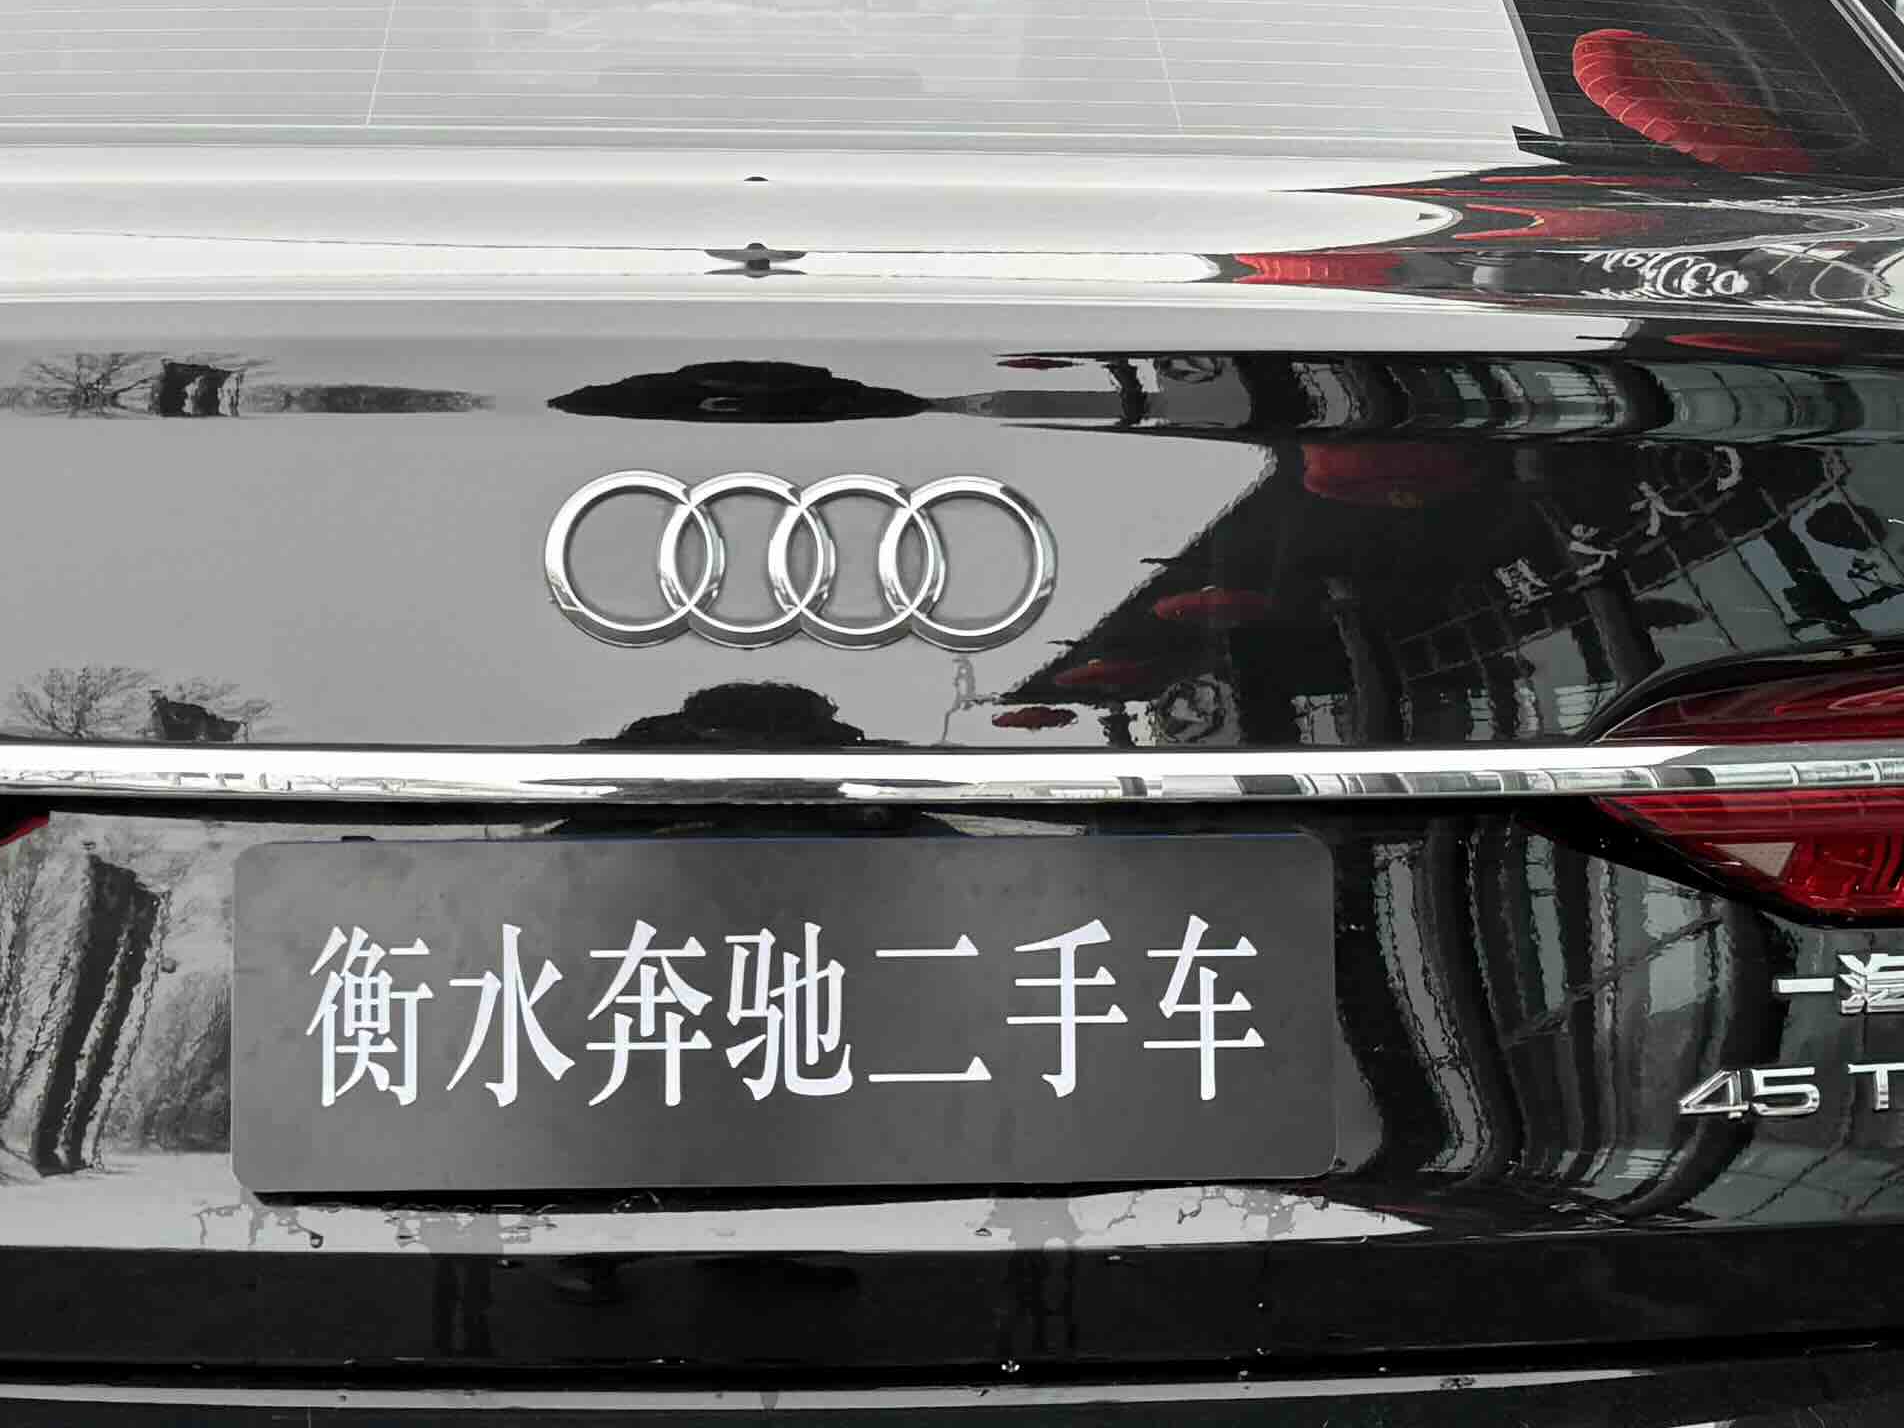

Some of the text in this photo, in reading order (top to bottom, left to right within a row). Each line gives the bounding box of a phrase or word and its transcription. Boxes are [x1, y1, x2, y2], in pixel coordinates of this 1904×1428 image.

[305, 914, 1266, 1108] 衡水奔驰二手车
[1678, 1065, 1822, 1120] 45
